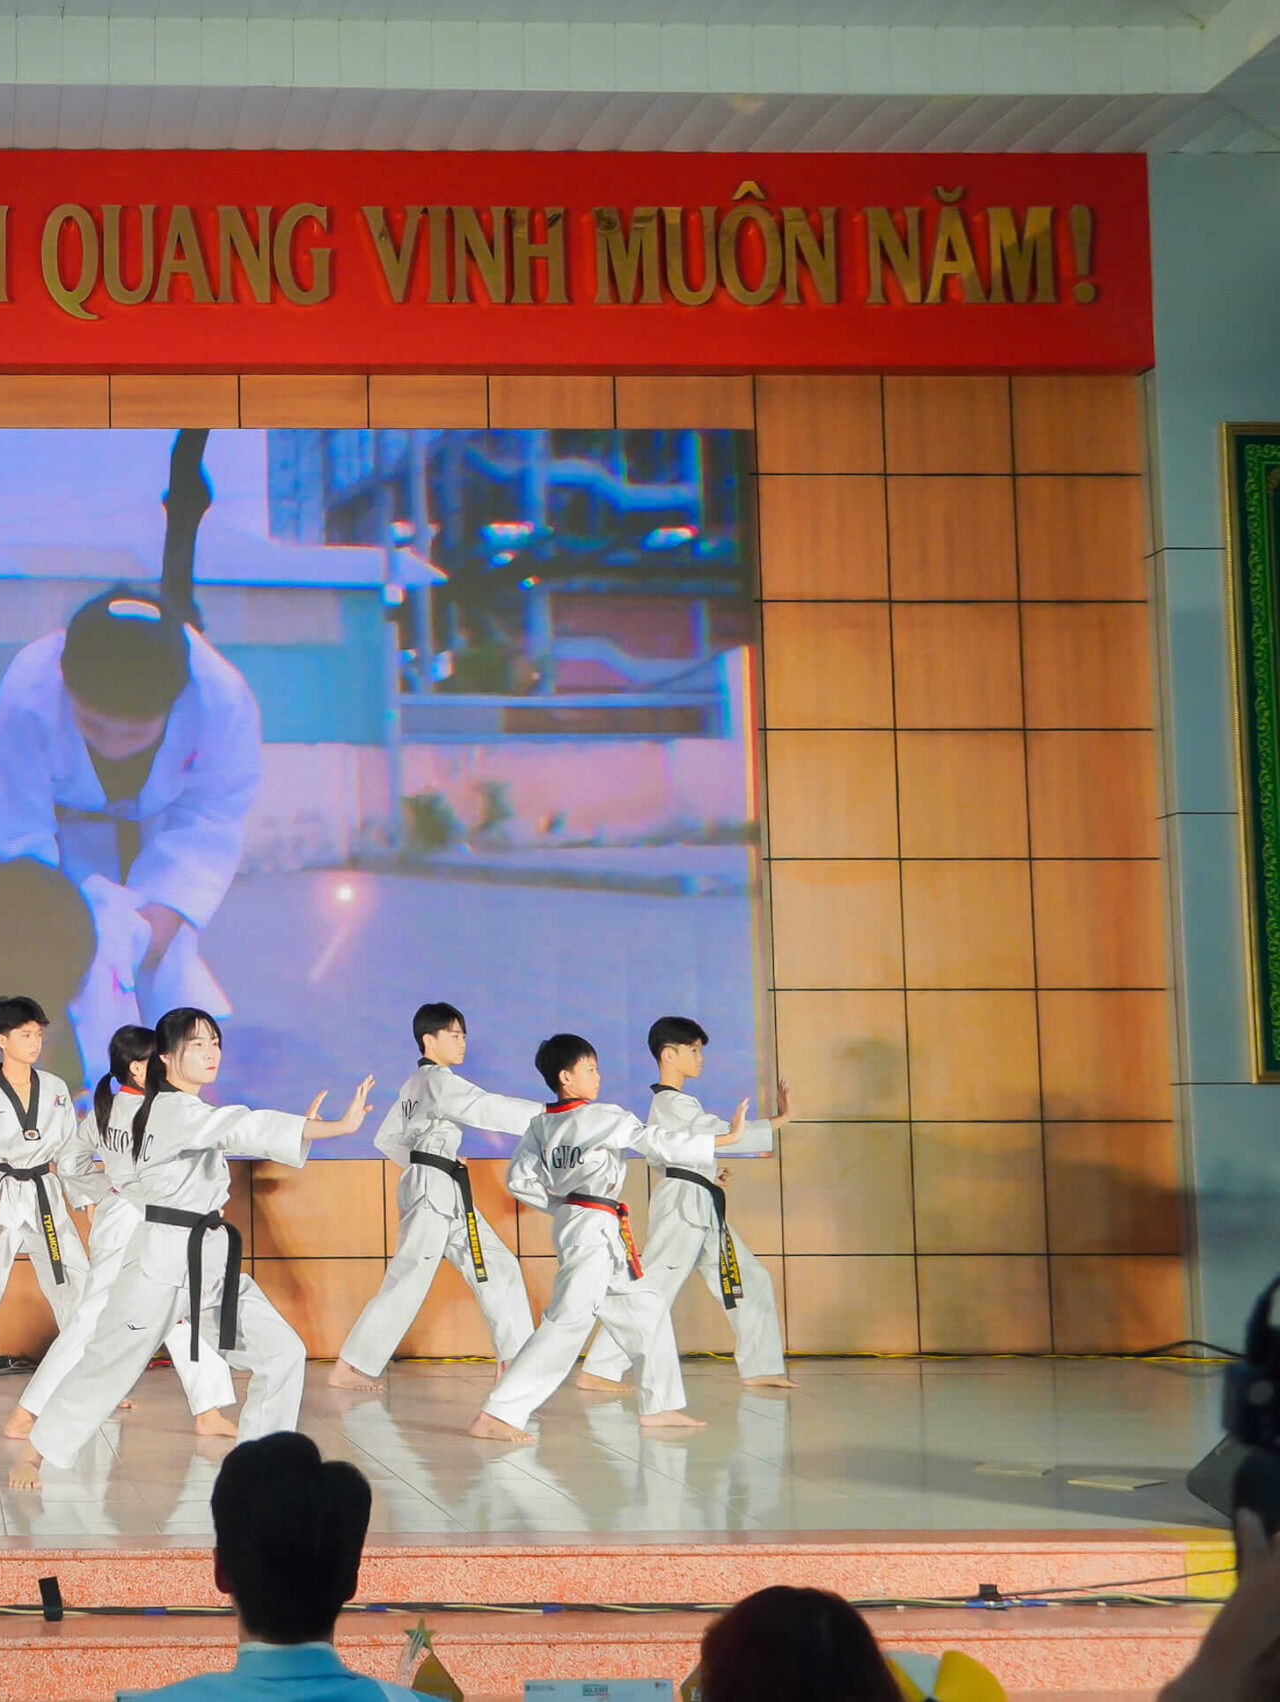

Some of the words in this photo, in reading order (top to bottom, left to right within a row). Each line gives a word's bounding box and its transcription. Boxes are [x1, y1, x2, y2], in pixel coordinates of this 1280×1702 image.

[40, 203, 331, 320] QUANG
[362, 206, 569, 304] VINH
[593, 181, 838, 306] MUÔN
